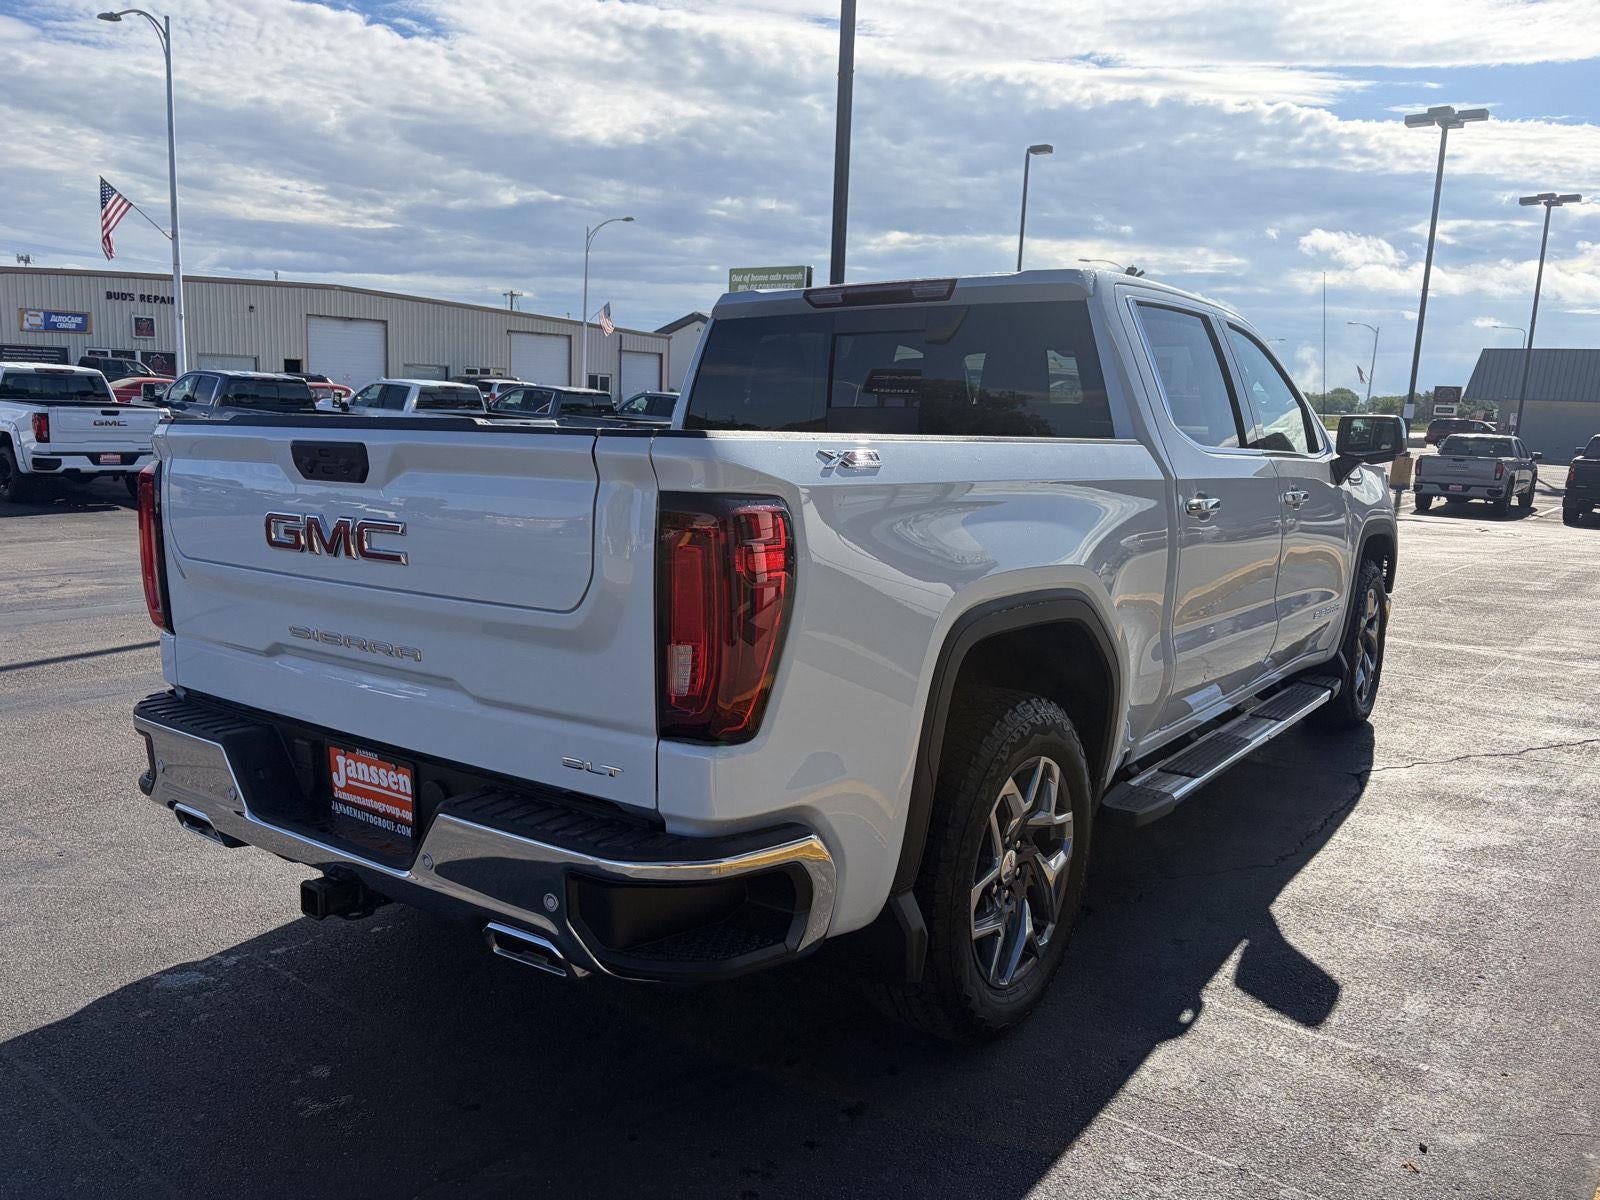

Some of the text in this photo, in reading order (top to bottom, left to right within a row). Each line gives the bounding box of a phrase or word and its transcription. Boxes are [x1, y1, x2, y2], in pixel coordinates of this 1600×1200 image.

[743, 273, 751, 283] of
[751, 273, 769, 281] home
[769, 272, 781, 281] ads
[782, 272, 803, 280] reach
[106, 291, 135, 302] BUD'S
[265, 511, 408, 566] GMC
[288, 624, 422, 663] SIERRA
[332, 755, 412, 795] Janssen
[561, 756, 624, 777] SLT
